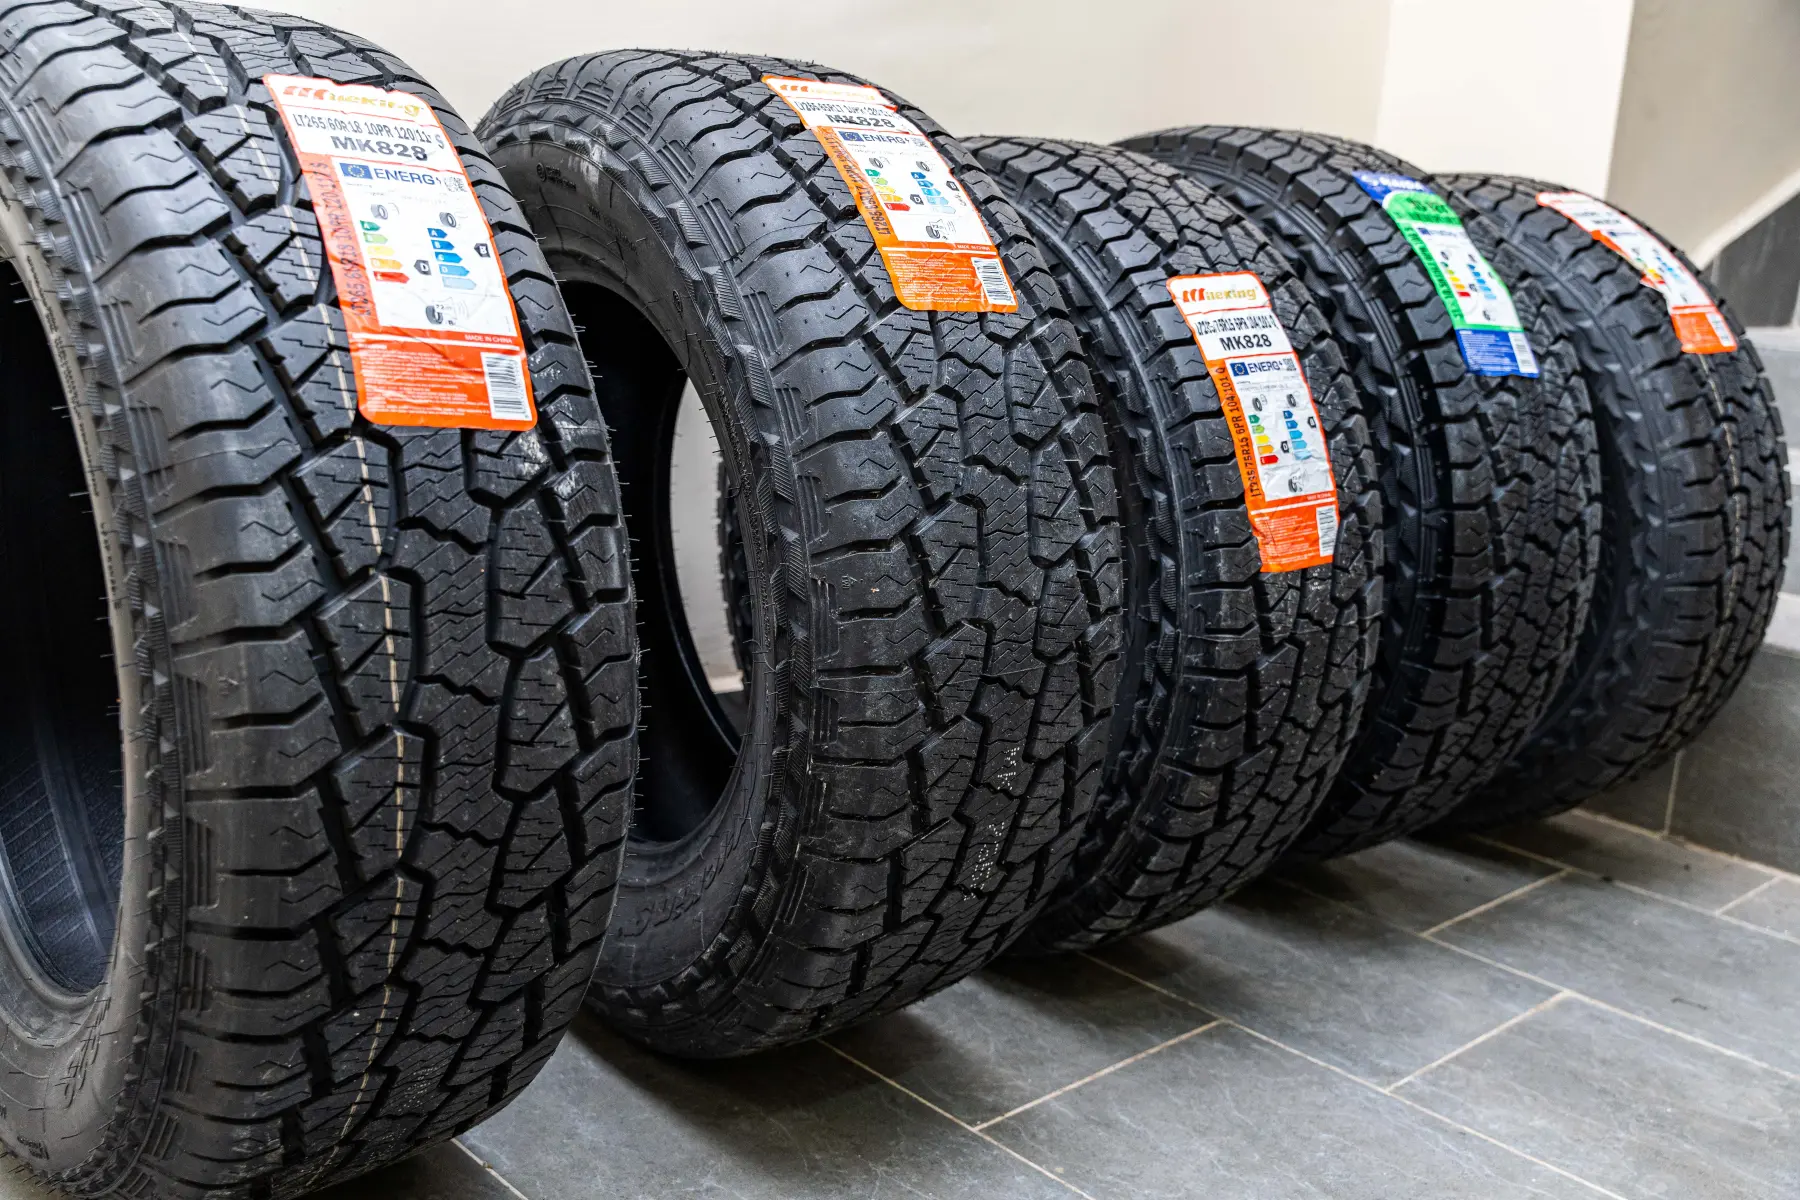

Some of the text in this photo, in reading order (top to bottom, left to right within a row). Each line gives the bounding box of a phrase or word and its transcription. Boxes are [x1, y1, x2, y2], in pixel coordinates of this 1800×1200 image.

[364, 121, 394, 138] 10PR
[825, 113, 896, 129] MK828
[330, 135, 428, 162] MK828
[1219, 333, 1272, 351] MK828
[1231, 415, 1246, 435] 6PR
